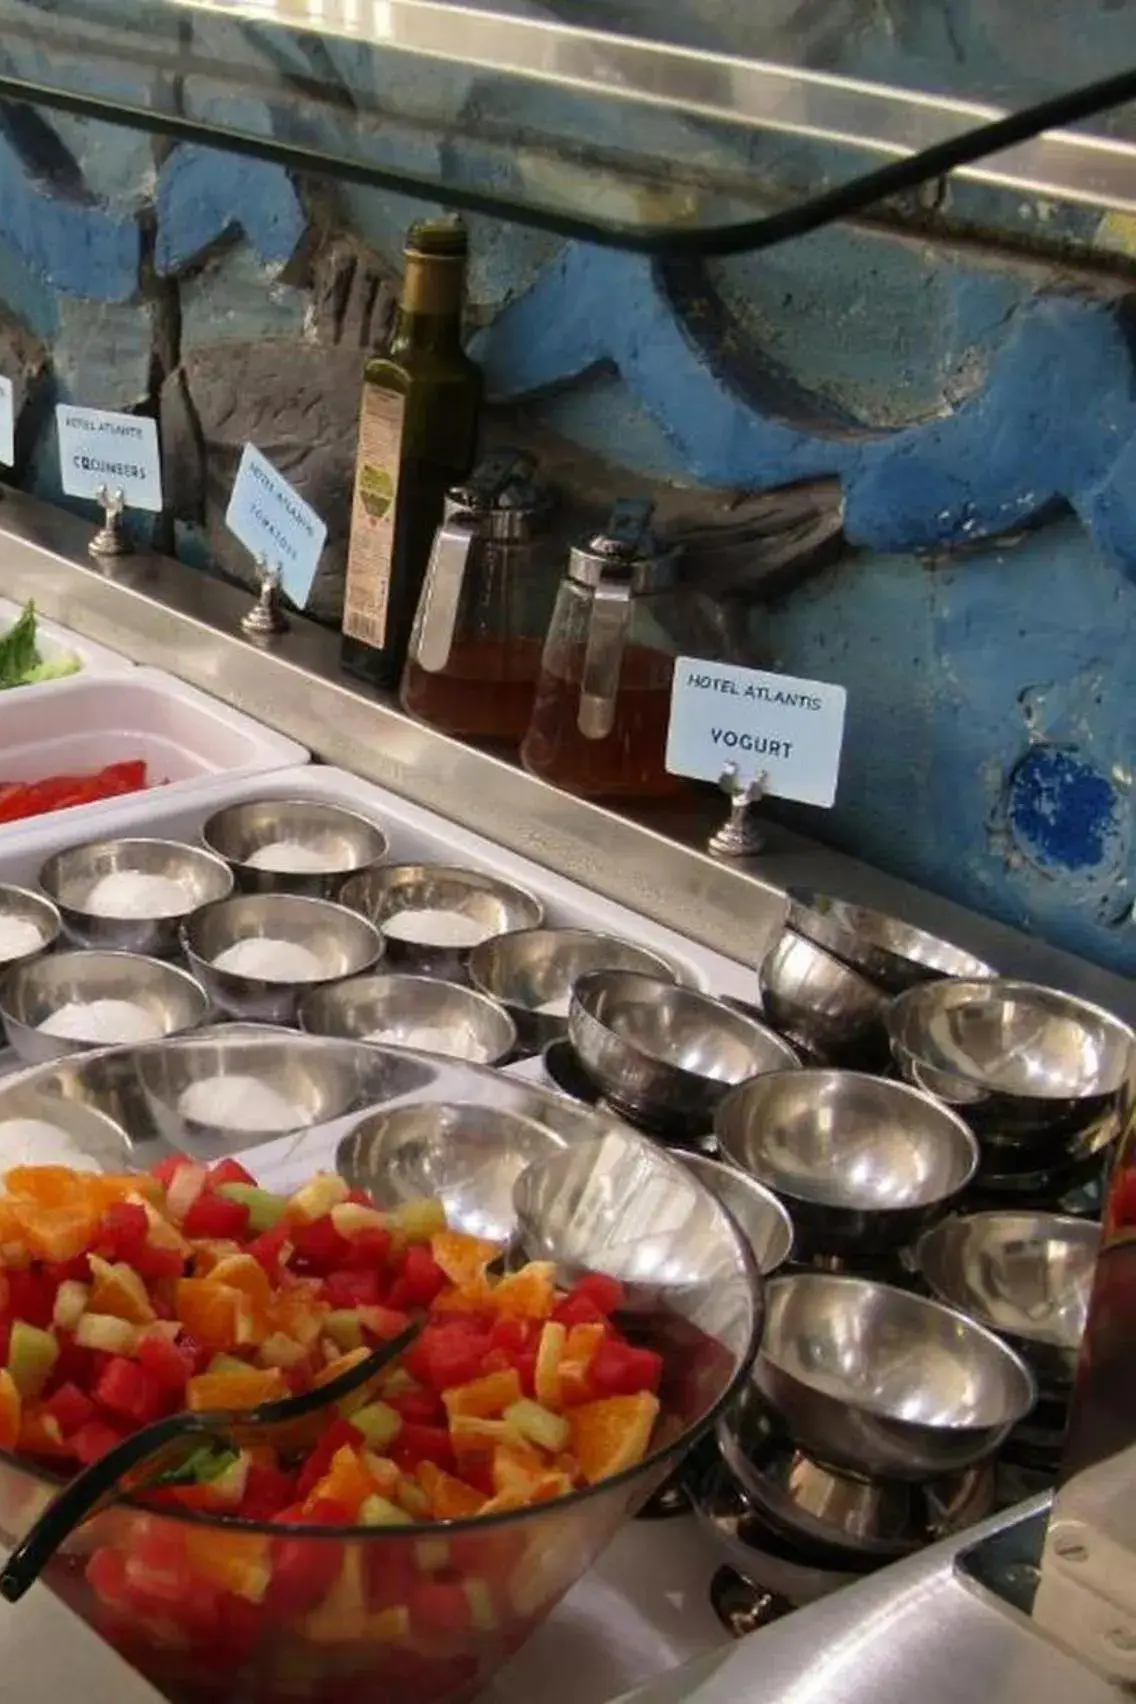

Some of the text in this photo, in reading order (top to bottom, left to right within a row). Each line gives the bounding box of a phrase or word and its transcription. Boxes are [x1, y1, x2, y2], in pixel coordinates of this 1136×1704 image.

[687, 673, 823, 712] HOTEL ATLANTIS
[710, 727, 794, 759] YOGURT
